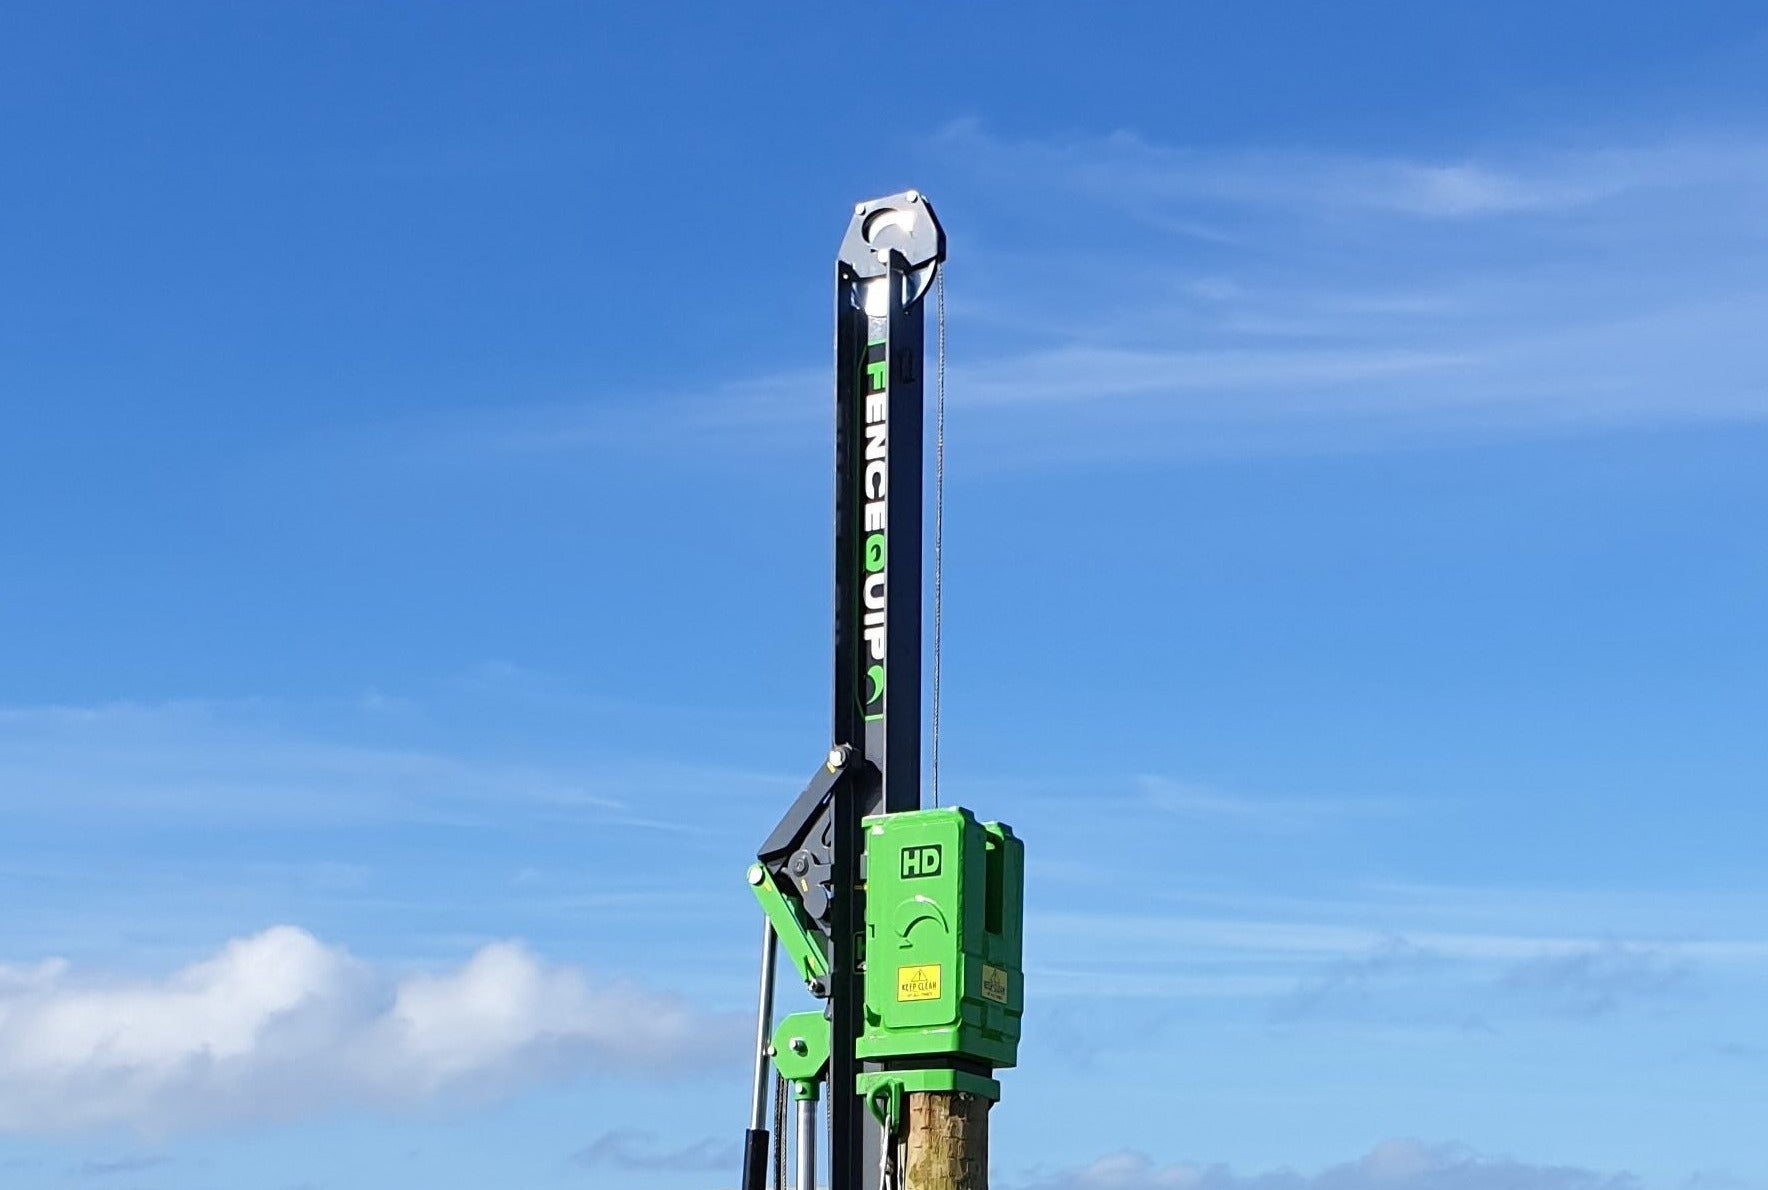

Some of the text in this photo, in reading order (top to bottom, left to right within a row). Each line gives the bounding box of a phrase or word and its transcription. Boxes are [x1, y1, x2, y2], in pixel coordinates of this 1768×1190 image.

[863, 361, 887, 661] FENCEQUIP
[903, 847, 940, 876] HD
[901, 982, 917, 992] KEEP
